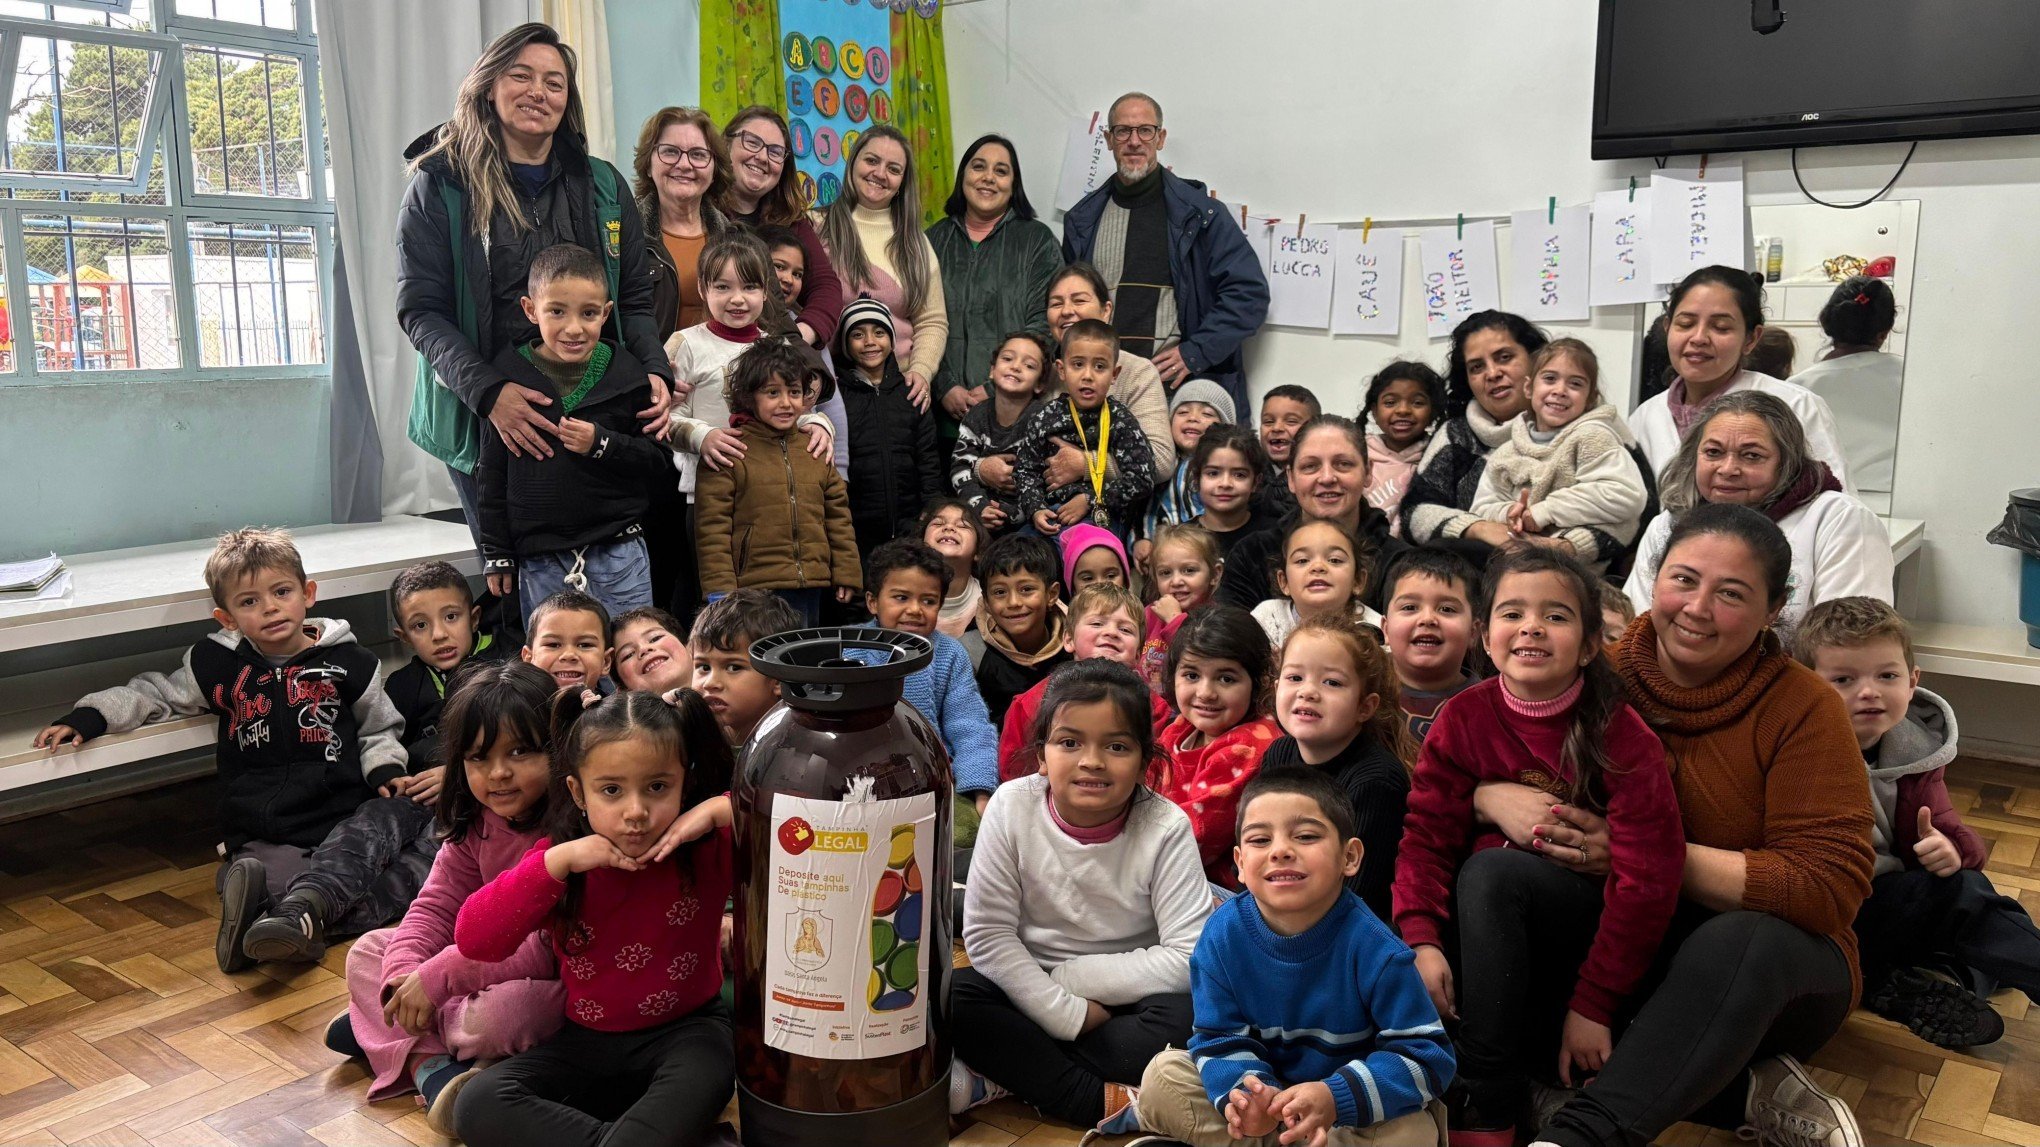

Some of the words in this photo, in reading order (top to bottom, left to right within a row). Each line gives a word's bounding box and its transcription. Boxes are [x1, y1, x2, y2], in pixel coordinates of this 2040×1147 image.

[790, 38, 804, 66] A
[846, 48, 860, 73] C
[872, 53, 883, 78] D
[791, 80, 803, 107] E
[820, 86, 831, 113] F
[850, 91, 863, 116] G
[1801, 113, 1820, 121] AOC
[820, 133, 831, 159] J
[1281, 236, 1330, 255] PEDRO
[1615, 214, 1636, 282] LARA
[1273, 261, 1321, 277] LUCCA
[1449, 249, 1473, 313] HEITOR
[815, 835, 865, 849] LEGAL
[778, 866, 820, 880] Deposite
[823, 874, 844, 883] aqui
[778, 875, 799, 887] Suas
[778, 884, 789, 895] De
